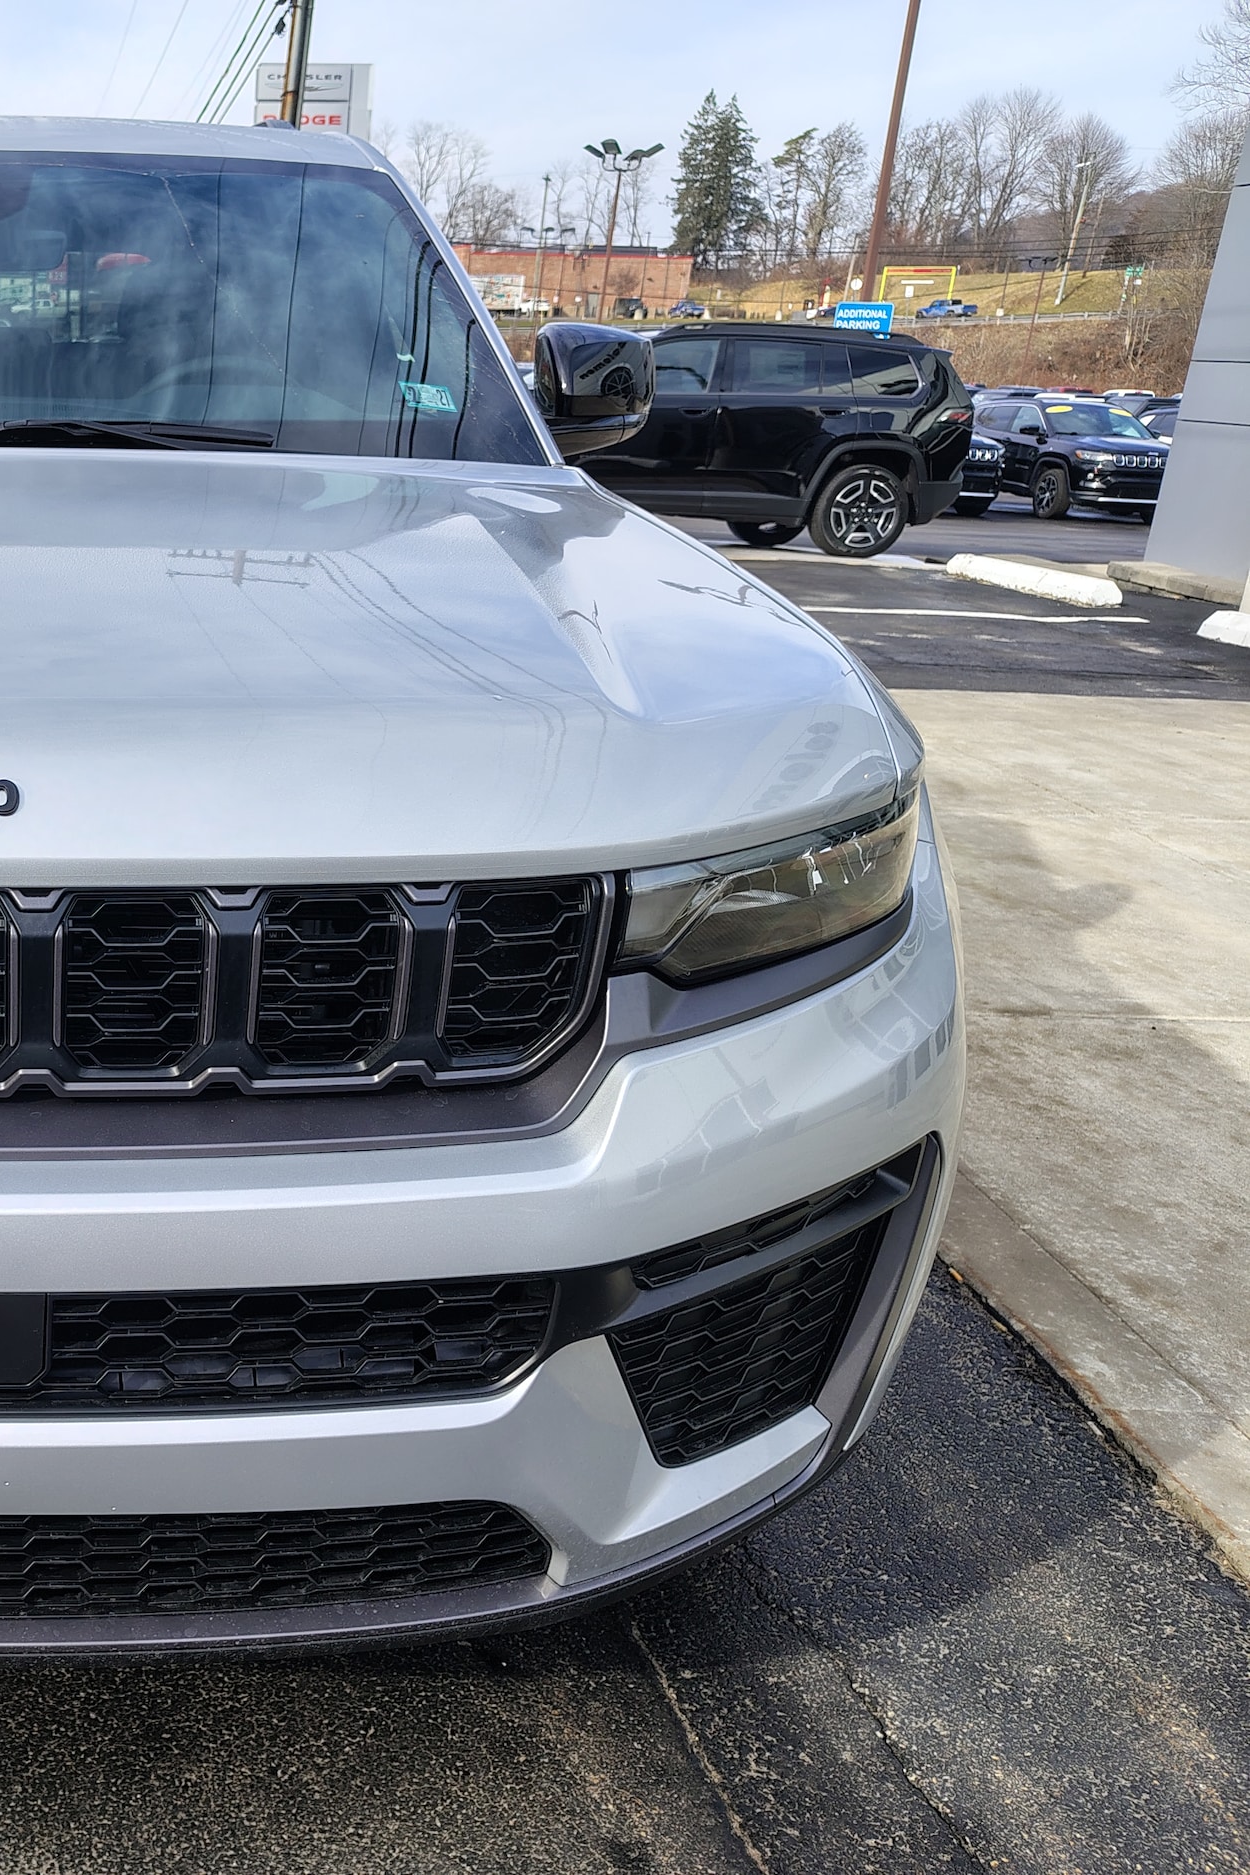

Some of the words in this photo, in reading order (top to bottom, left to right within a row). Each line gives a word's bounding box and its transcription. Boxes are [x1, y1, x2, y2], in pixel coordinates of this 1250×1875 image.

[263, 115, 342, 126] DDGE
[837, 309, 888, 319] ADDITIONAL
[835, 320, 881, 330] PARKING
